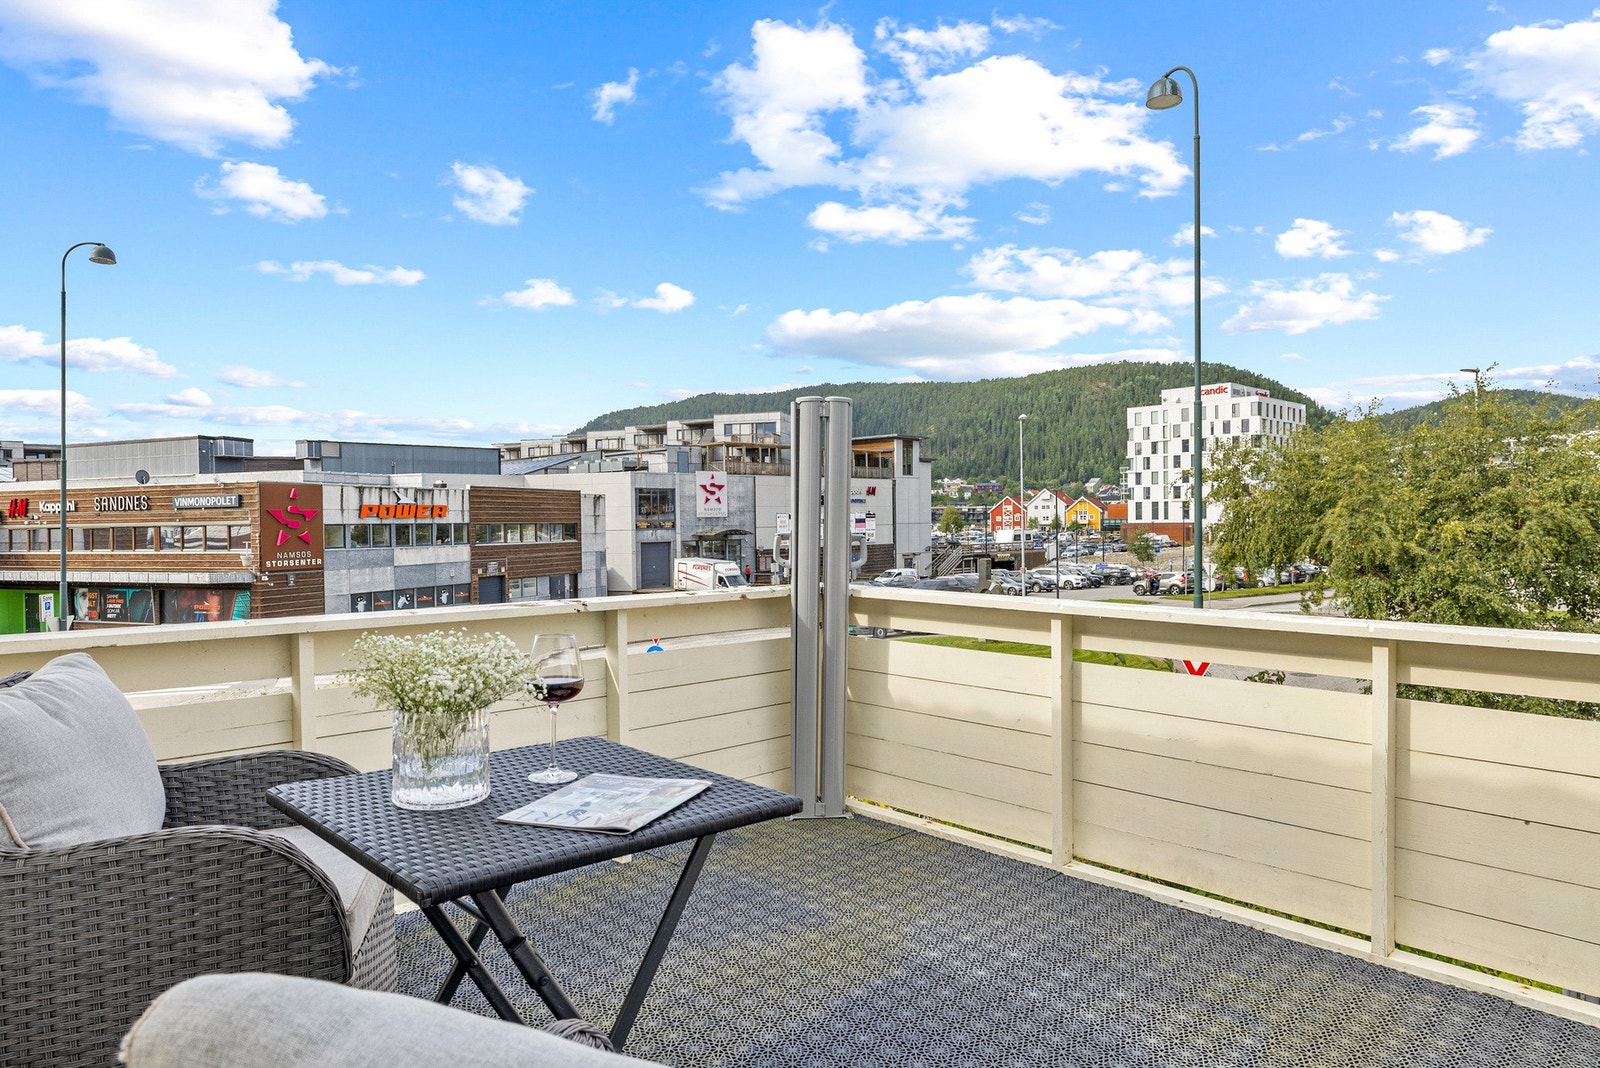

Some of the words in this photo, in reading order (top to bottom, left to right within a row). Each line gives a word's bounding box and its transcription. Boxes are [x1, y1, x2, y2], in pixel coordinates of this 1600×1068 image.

[1199, 385, 1228, 396] candic
[94, 495, 150, 511] SANDNES
[175, 496, 236, 506] VINMONOPOLET
[39, 500, 76, 514] Kapphl
[360, 504, 448, 519] POWER
[276, 551, 312, 559] NAMSOS
[265, 558, 322, 568] STORSENTER
